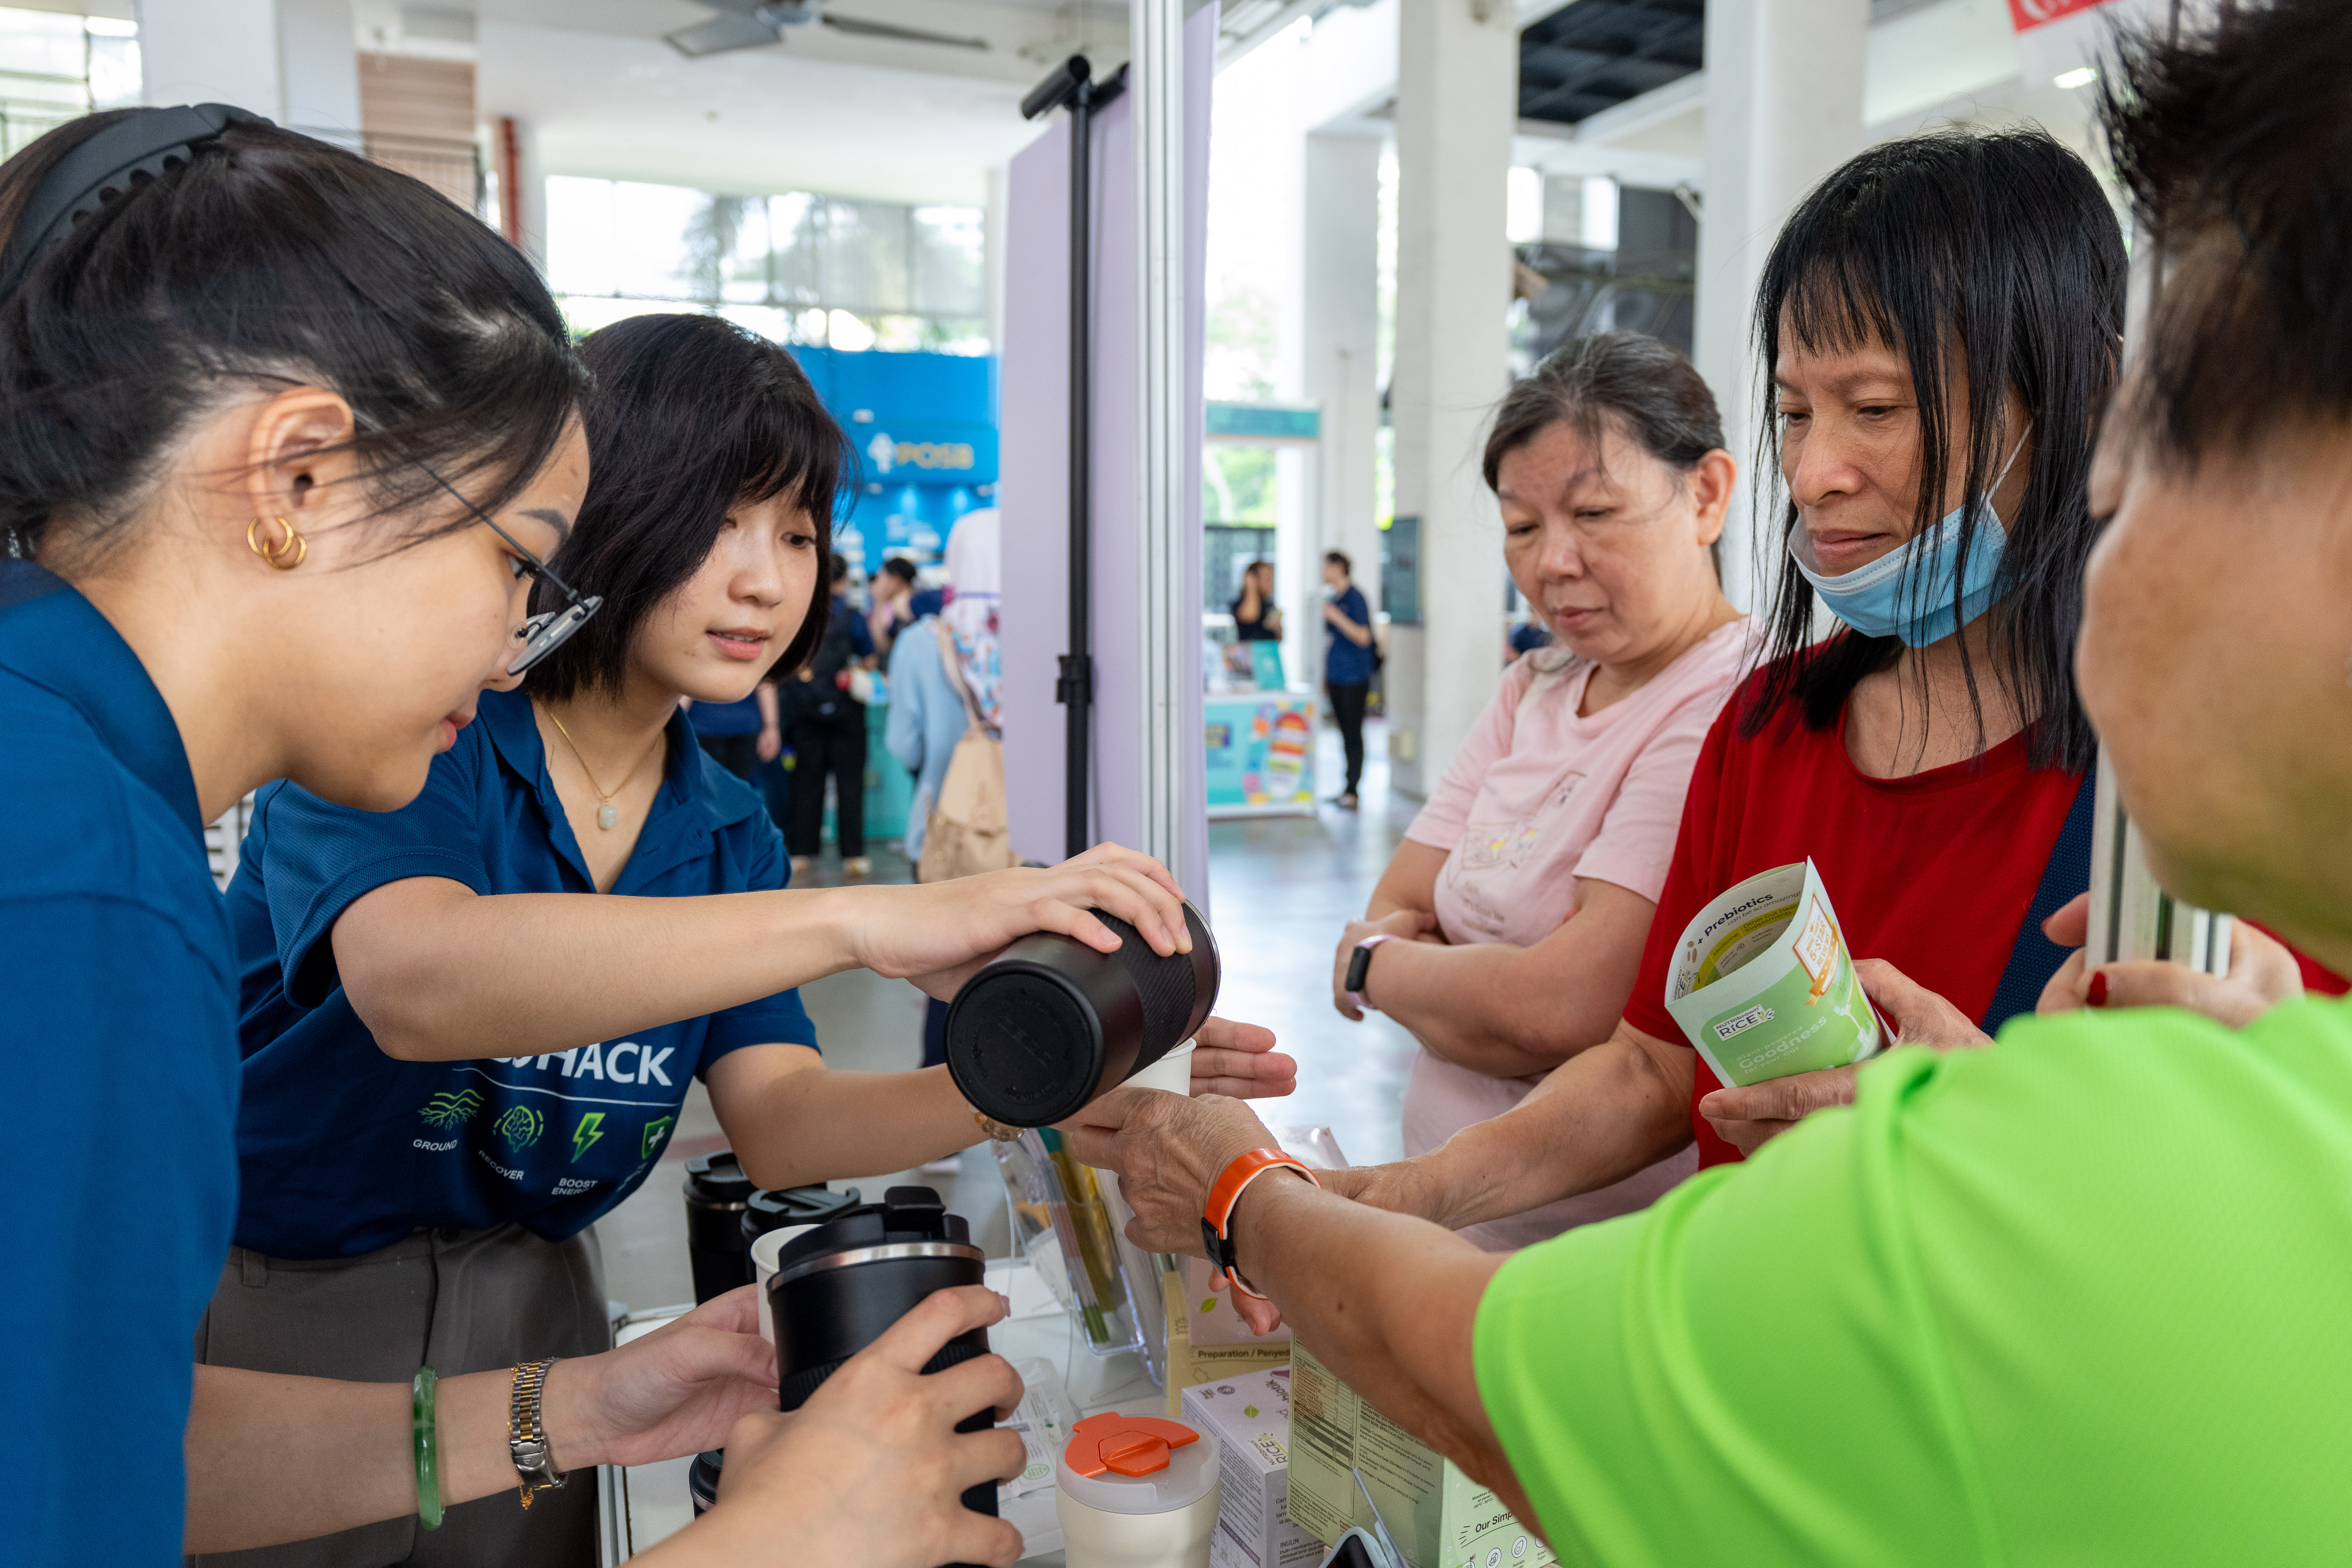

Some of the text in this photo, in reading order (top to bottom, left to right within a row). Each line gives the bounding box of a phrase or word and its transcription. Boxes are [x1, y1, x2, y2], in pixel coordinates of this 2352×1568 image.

[1704, 894, 1773, 936] Prebiotics
[1728, 916, 1741, 926] can
[1764, 891, 1801, 908] amazing!
[1743, 917, 1764, 929] Other
[1745, 911, 1793, 932] Supplements
[1751, 927, 1773, 940] Artificially
[1810, 920, 1826, 961] 5-STAR
[1713, 933, 1739, 956] Medicine
[1816, 931, 1830, 967] REVIEWS
[1720, 950, 1734, 965] Artificial
[1716, 1007, 1759, 1029] NUTRIbrown
[1739, 1016, 1828, 1068] Goodness
[1761, 1056, 1780, 1067] your
[413, 1139, 458, 1151] GROUND
[478, 1150, 524, 1180] RECOVER
[559, 1178, 598, 1188] BOOST
[1198, 1350, 1249, 1359] Preparation
[1257, 1349, 1290, 1358] Penyed
[1360, 1405, 1372, 1415] GLUTEN
[1360, 1409, 1375, 1421] Maklumat
[1388, 1425, 1398, 1433] BEBAS
[1360, 1414, 1370, 1423] BEBAS
[1380, 1425, 1390, 1434] BEBAS
[1360, 1424, 1371, 1434] Storage
[1372, 1430, 1389, 1443] Conditions:
[1389, 1440, 1397, 1448] Store
[1359, 1428, 1372, 1439] Keadaan
[1395, 1448, 1406, 1458] Simpan
[1410, 1457, 1422, 1467] tempat
[1359, 1442, 1372, 1453] Consume
[1372, 1450, 1381, 1459] Before
[1424, 1479, 1435, 1488] bottom
[1364, 1469, 1375, 1479] Weight
[1472, 1490, 1487, 1500] Masukkan
[1475, 1511, 1513, 1533] Our Simp
[1280, 1538, 1299, 1548] INULIN
[1291, 1542, 1312, 1552] membantu
[1280, 1549, 1307, 1560] bifidobakteria
[1280, 1555, 1304, 1566] persekitaran
